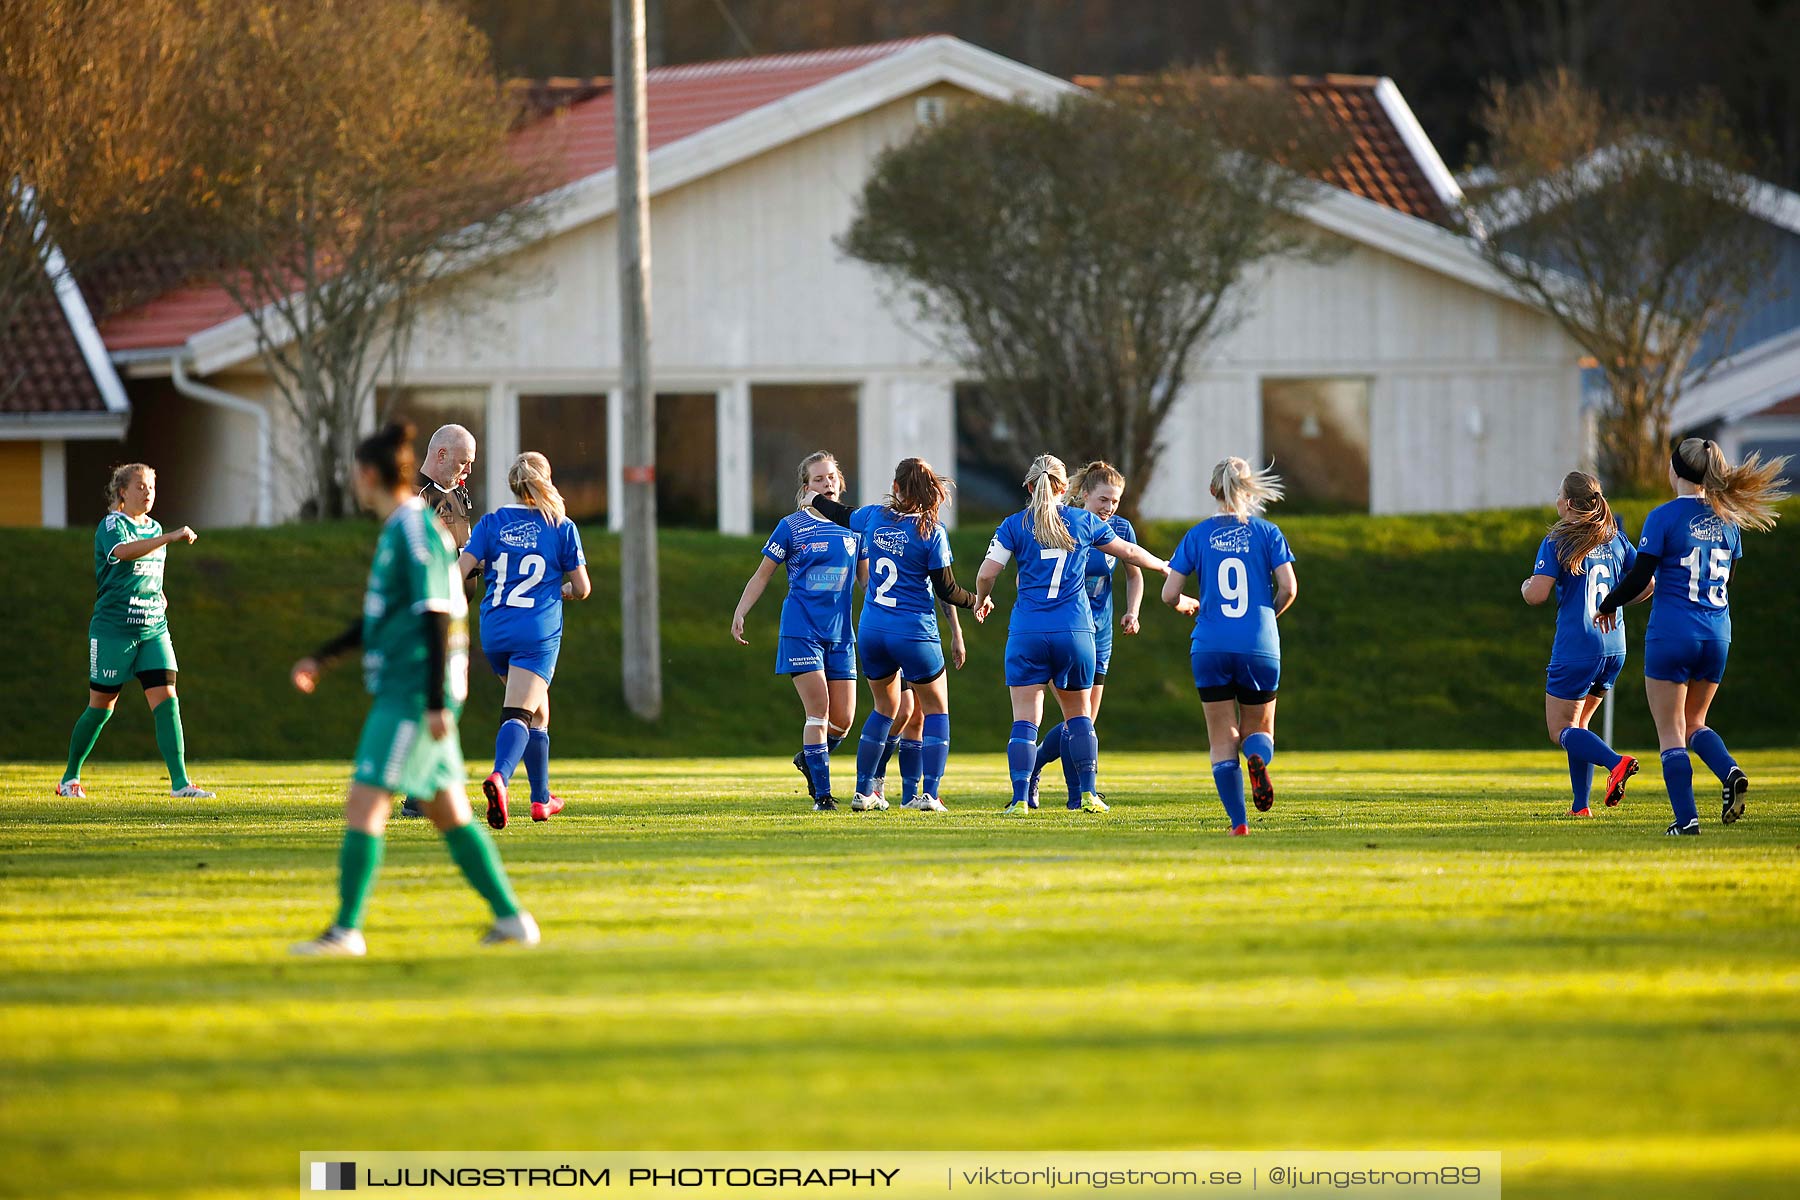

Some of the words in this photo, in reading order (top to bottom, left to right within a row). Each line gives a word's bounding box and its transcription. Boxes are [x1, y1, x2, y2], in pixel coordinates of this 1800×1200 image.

[492, 552, 545, 608] 12
[874, 557, 898, 608] 2
[1040, 548, 1068, 599] 7
[1218, 558, 1248, 618] 9
[1588, 564, 1611, 619] 6
[1681, 547, 1731, 607] 15
[102, 669, 117, 678] VIF
